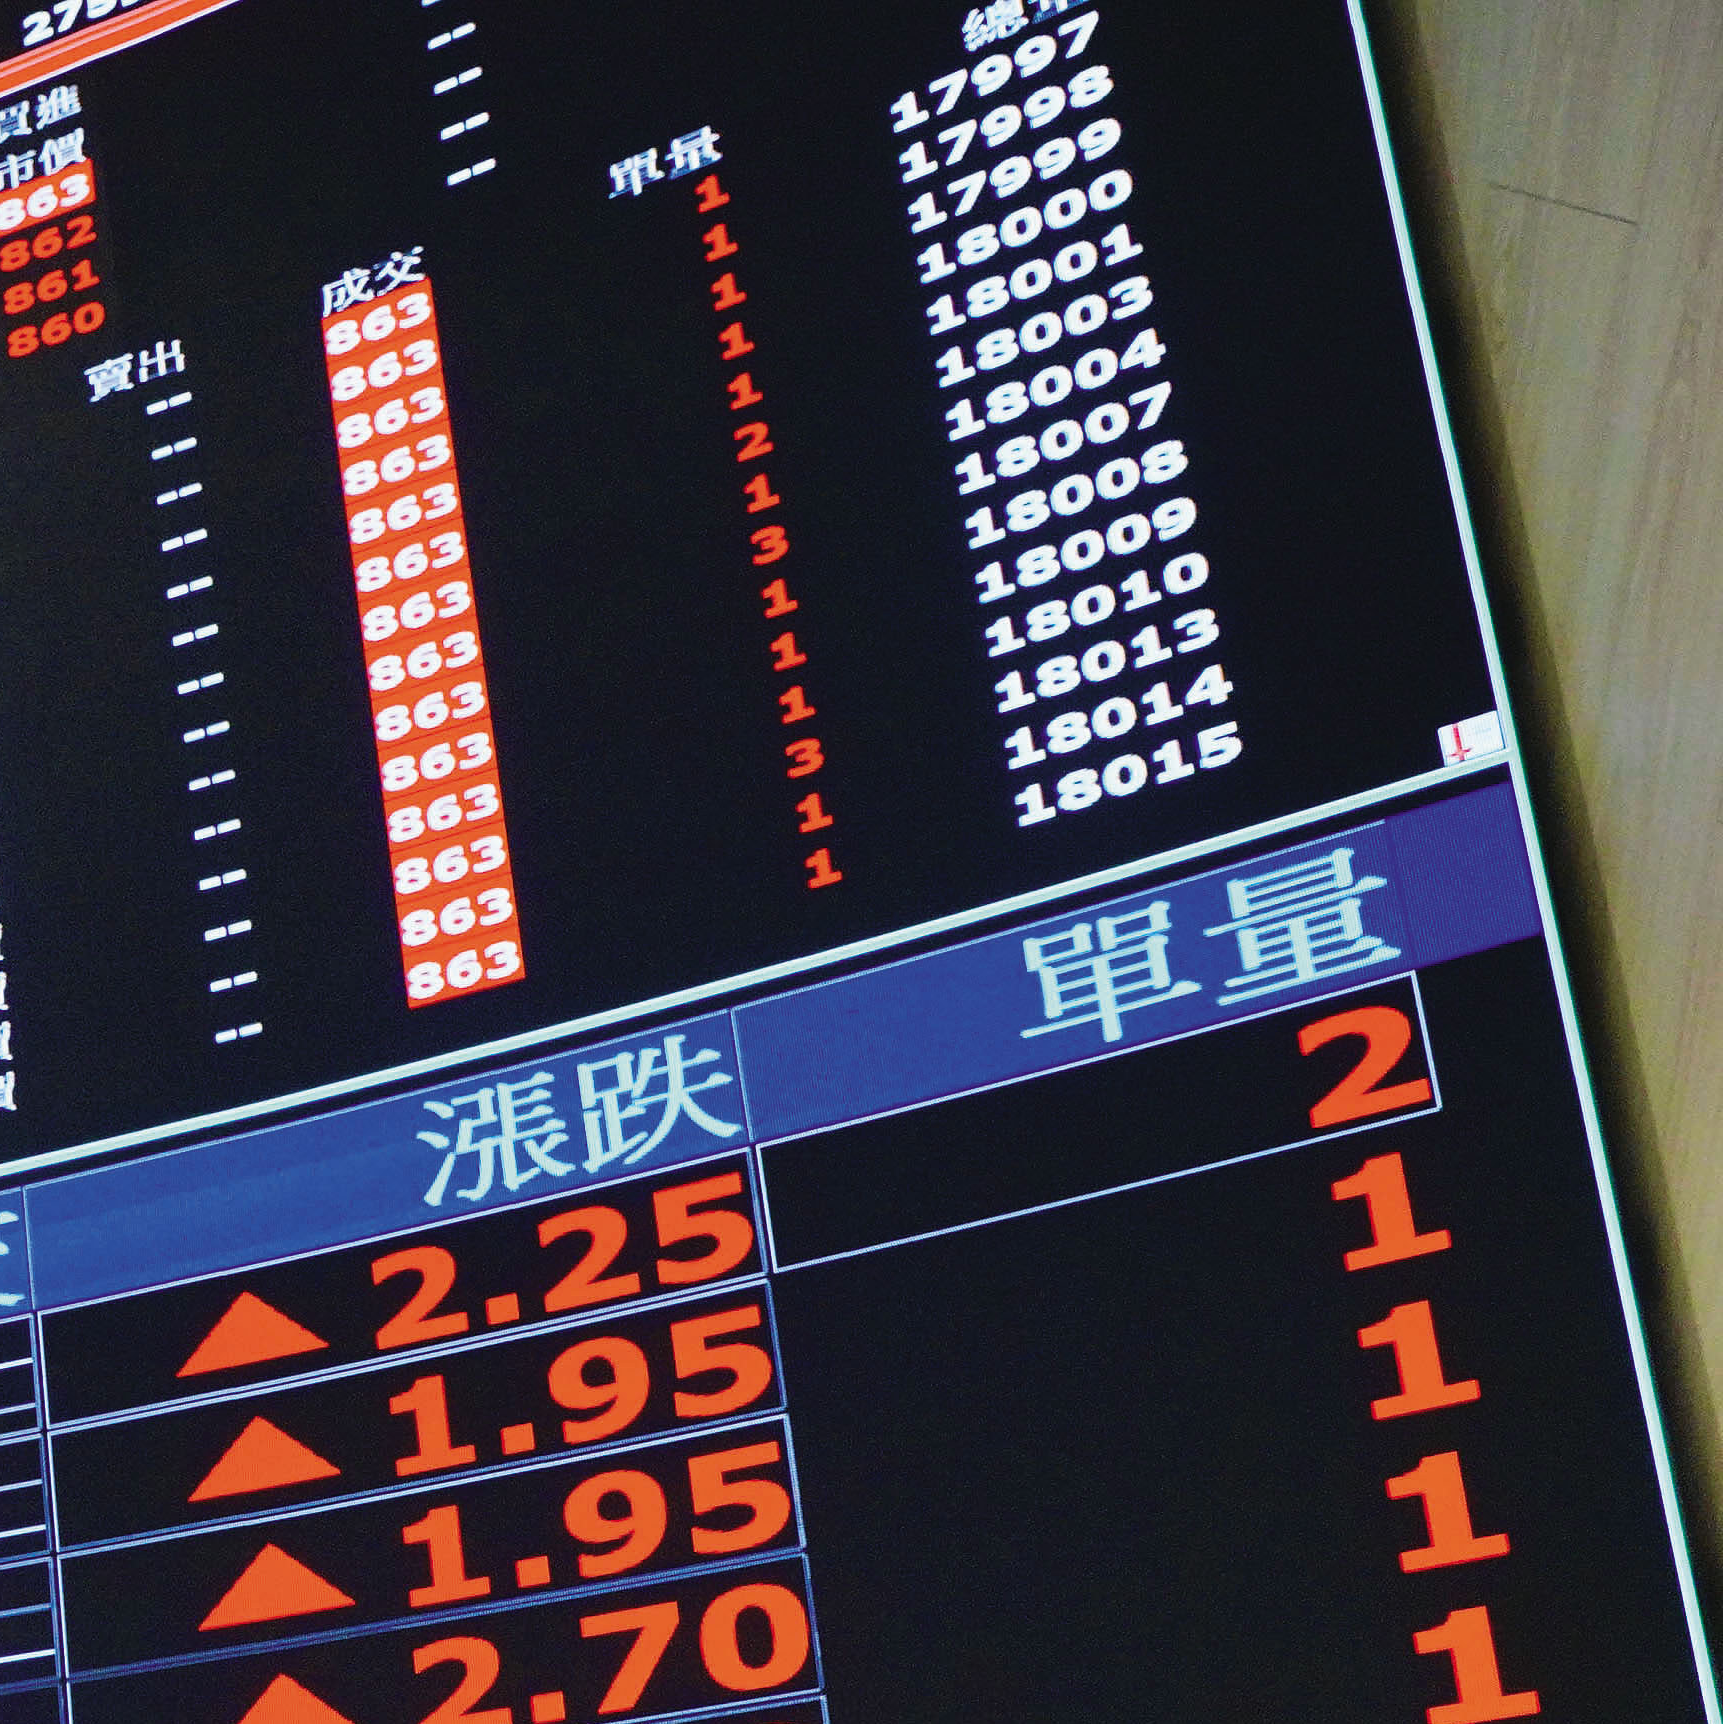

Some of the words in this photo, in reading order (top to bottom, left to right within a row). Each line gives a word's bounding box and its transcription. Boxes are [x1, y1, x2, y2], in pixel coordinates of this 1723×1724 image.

[891, 11, 1098, 132] 17997
[908, 119, 1121, 233] 17999
[0, 216, 96, 272] 862
[3, 260, 99, 314] 861
[927, 224, 1143, 335] 18001
[8, 302, 105, 357] 860
[325, 293, 431, 355] 863
[946, 328, 1166, 441] 18004
[966, 440, 1188, 549] 18008
[986, 553, 1208, 657] 18010
[369, 632, 478, 691] 863
[995, 609, 1219, 713] 18013
[1015, 721, 1241, 826] 18015
[407, 941, 520, 999] 863
[1020, 848, 1403, 1042] 單量
[416, 1029, 747, 1206] 漲跌
[1298, 1006, 1432, 1128] 2
[372, 1172, 753, 1349] 2.25
[1331, 1152, 1451, 1271] 1
[389, 1304, 772, 1476] 1.95
